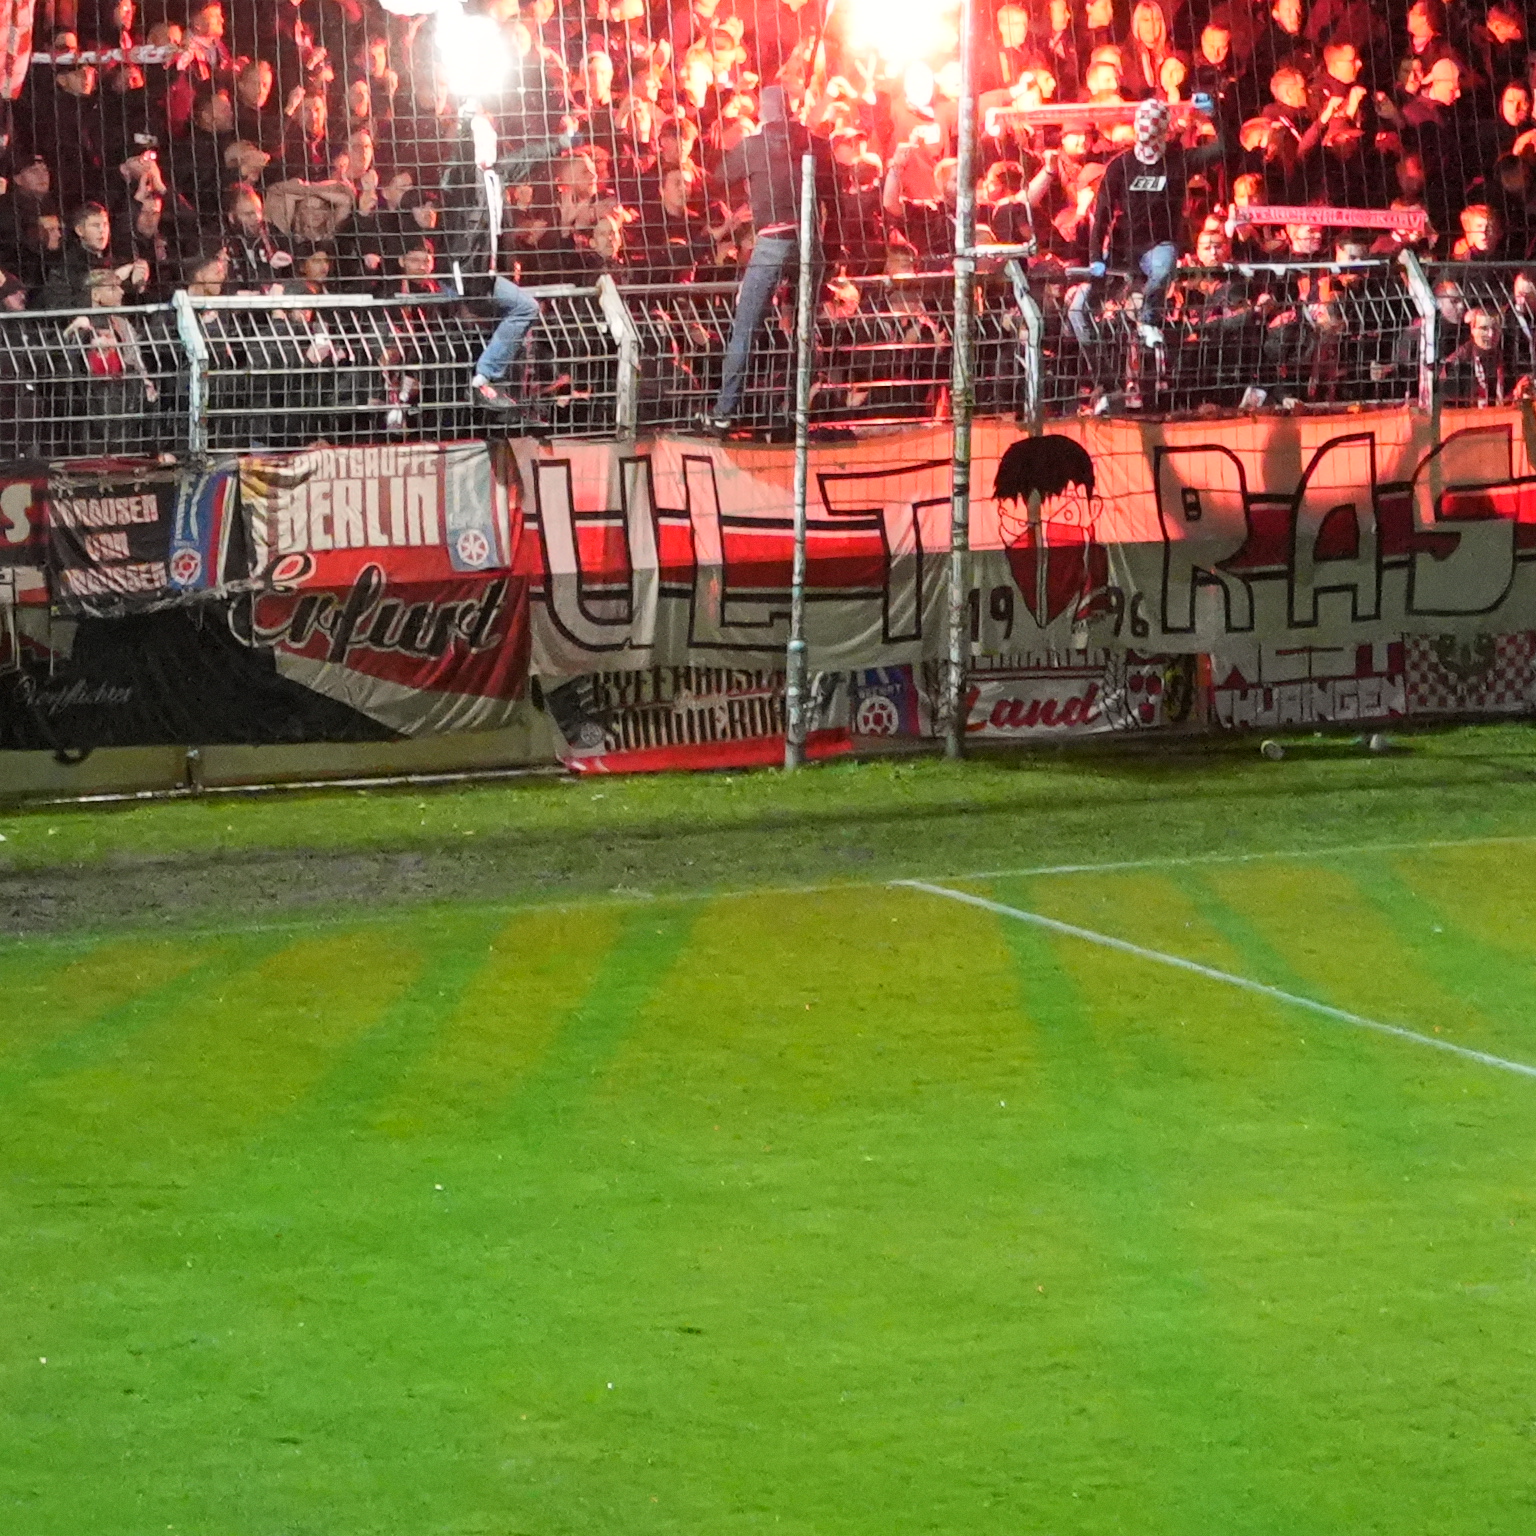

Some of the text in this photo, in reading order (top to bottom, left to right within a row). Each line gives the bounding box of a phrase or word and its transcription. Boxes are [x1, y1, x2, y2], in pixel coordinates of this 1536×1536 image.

[277, 474, 440, 555] BERLIN
[531, 424, 1516, 652] ULTRAS
[229, 552, 509, 664] Erfurt
